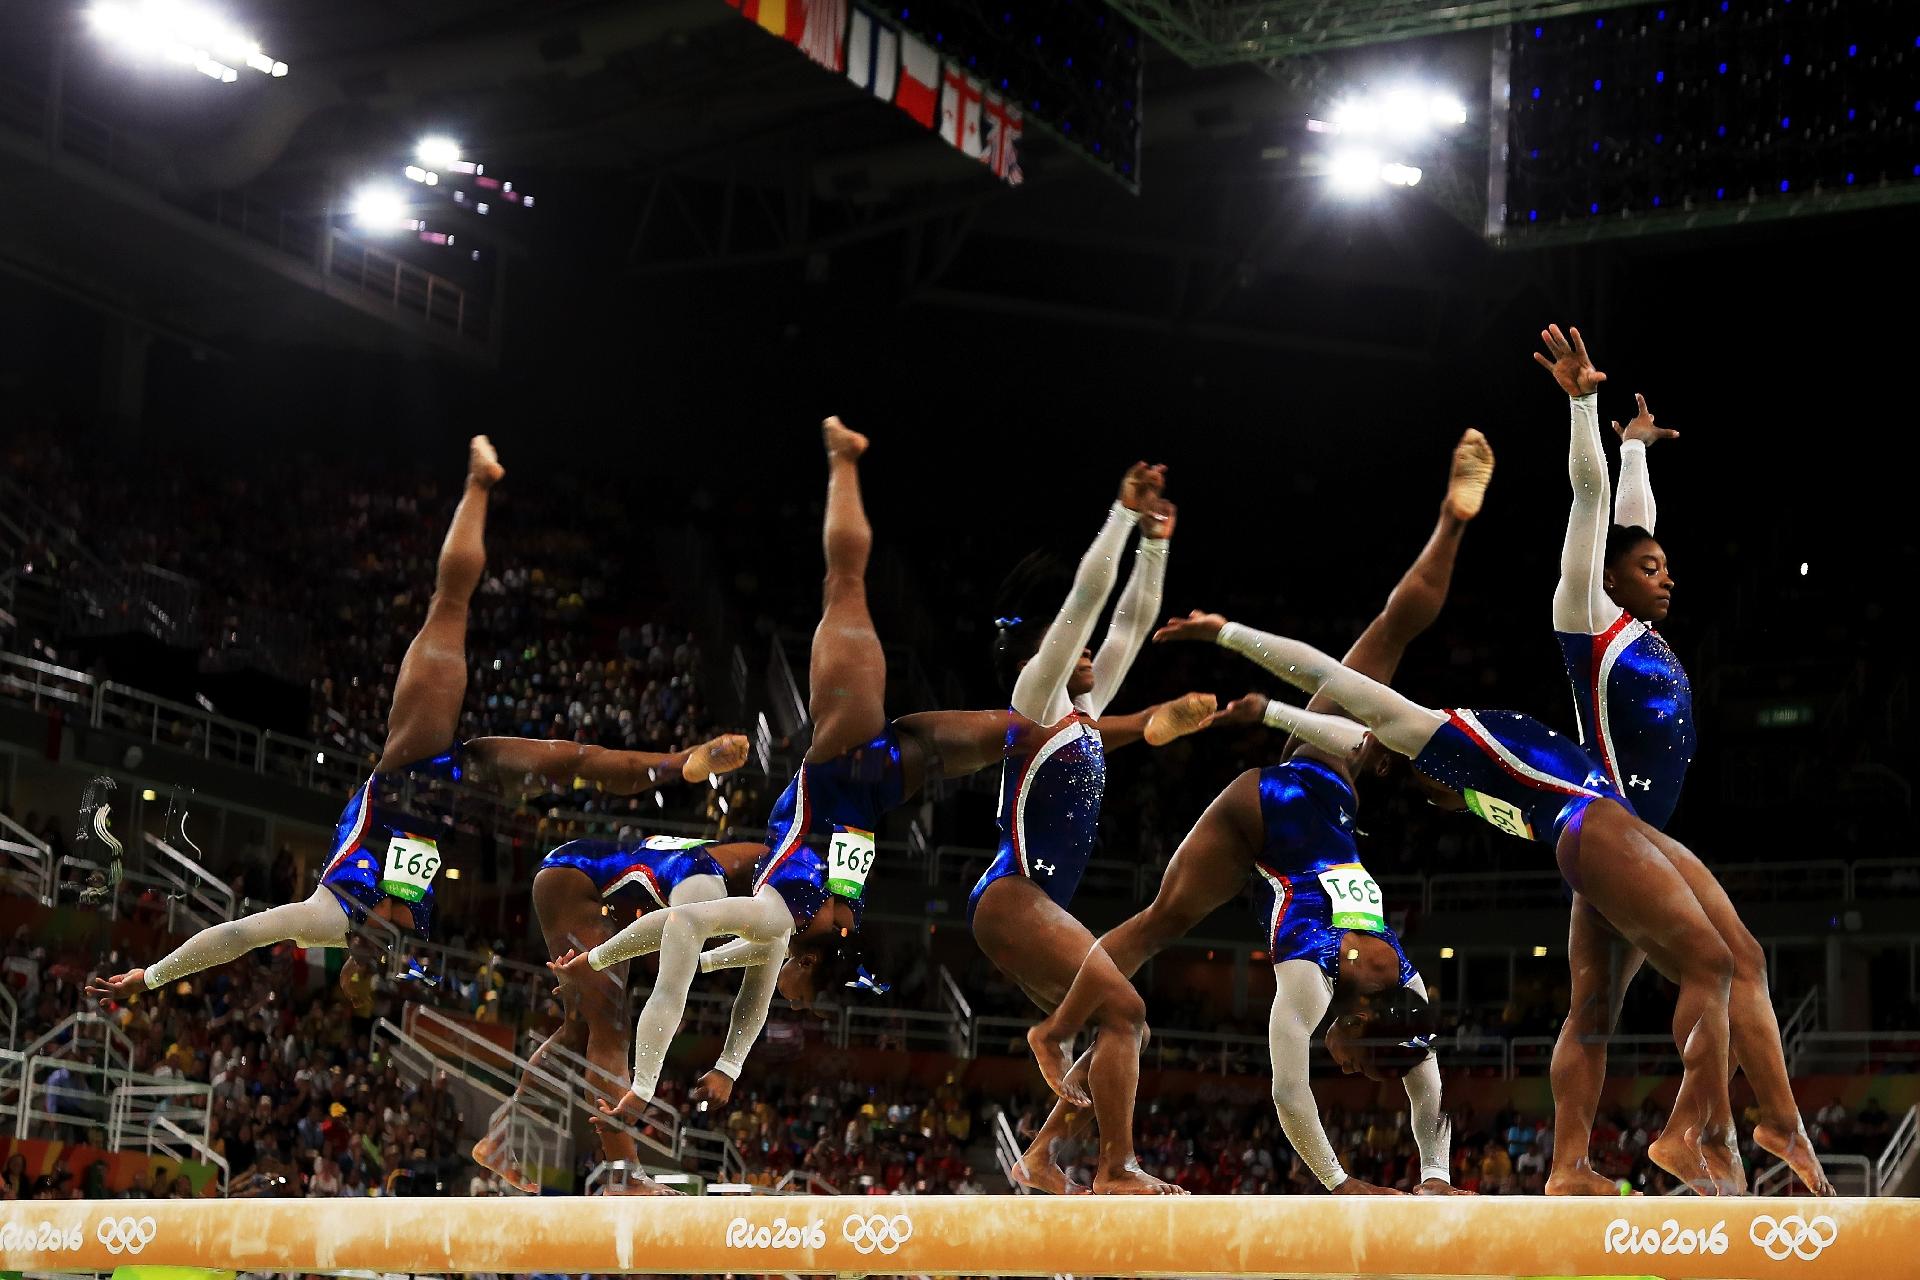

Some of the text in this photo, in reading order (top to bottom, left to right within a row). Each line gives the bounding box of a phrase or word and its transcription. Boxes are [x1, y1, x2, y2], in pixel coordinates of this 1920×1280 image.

[393, 845, 439, 879] 391
[835, 841, 874, 874] 391
[1326, 878, 1380, 904] 391
[725, 1217, 827, 1250] Rio2016
[1604, 1218, 1729, 1254] Rio2016
